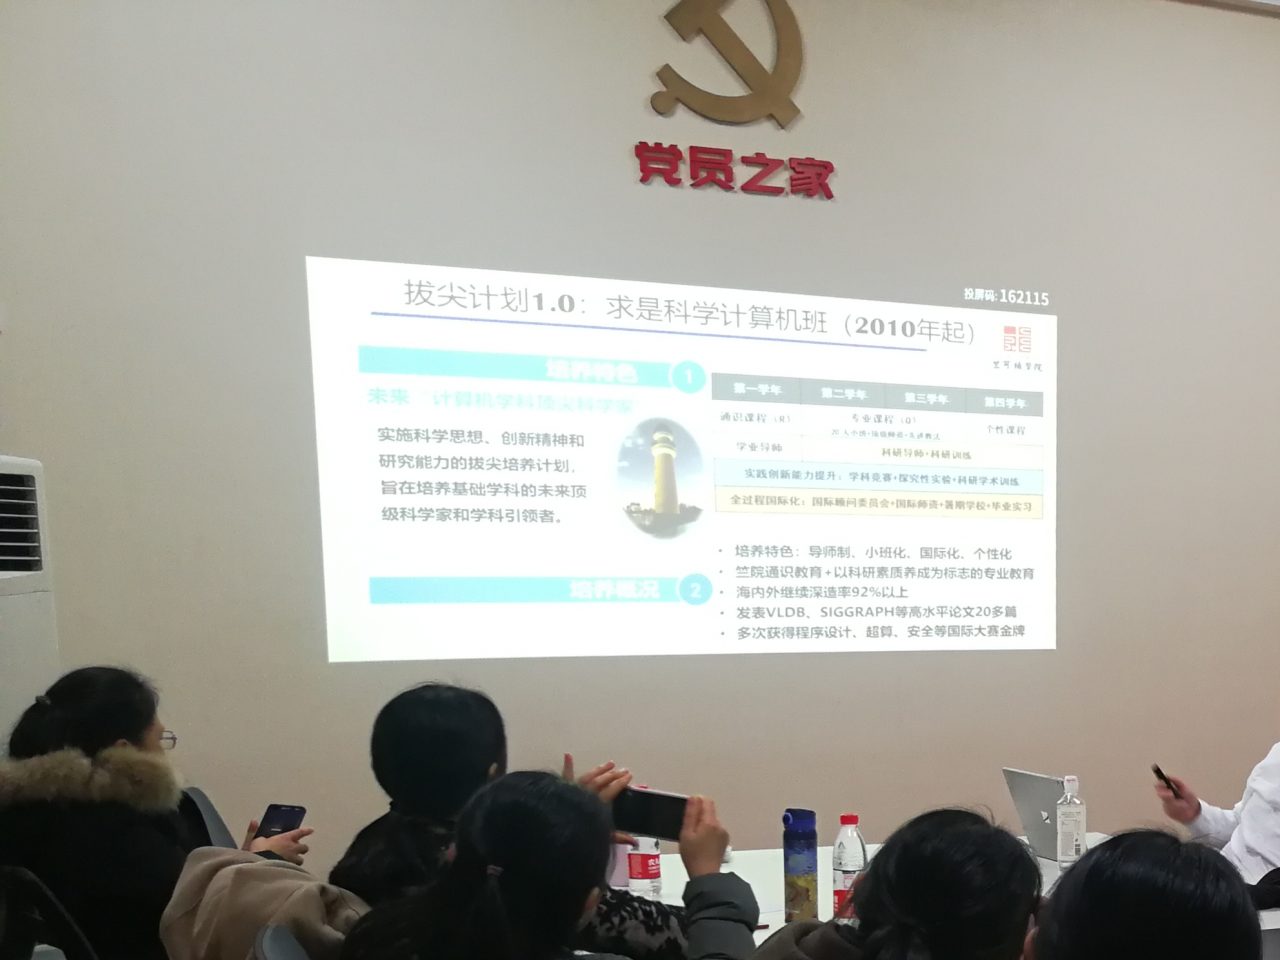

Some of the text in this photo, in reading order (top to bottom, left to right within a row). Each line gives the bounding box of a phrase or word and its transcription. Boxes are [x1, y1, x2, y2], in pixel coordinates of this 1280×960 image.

[634, 141, 834, 200] 党员之家
[1000, 288, 1049, 306] 162115
[733, 382, 783, 396] 第一学年
[821, 387, 869, 401] 第二学年
[904, 392, 950, 406] 第三学年
[377, 426, 585, 448] 实施科学思想、创新精神和
[381, 480, 587, 498] 旨在培养基础学科的未来顶
[381, 506, 561, 524] 级科学家和学科引领者。
[736, 585, 909, 599] 海内外继续深造率92%以上
